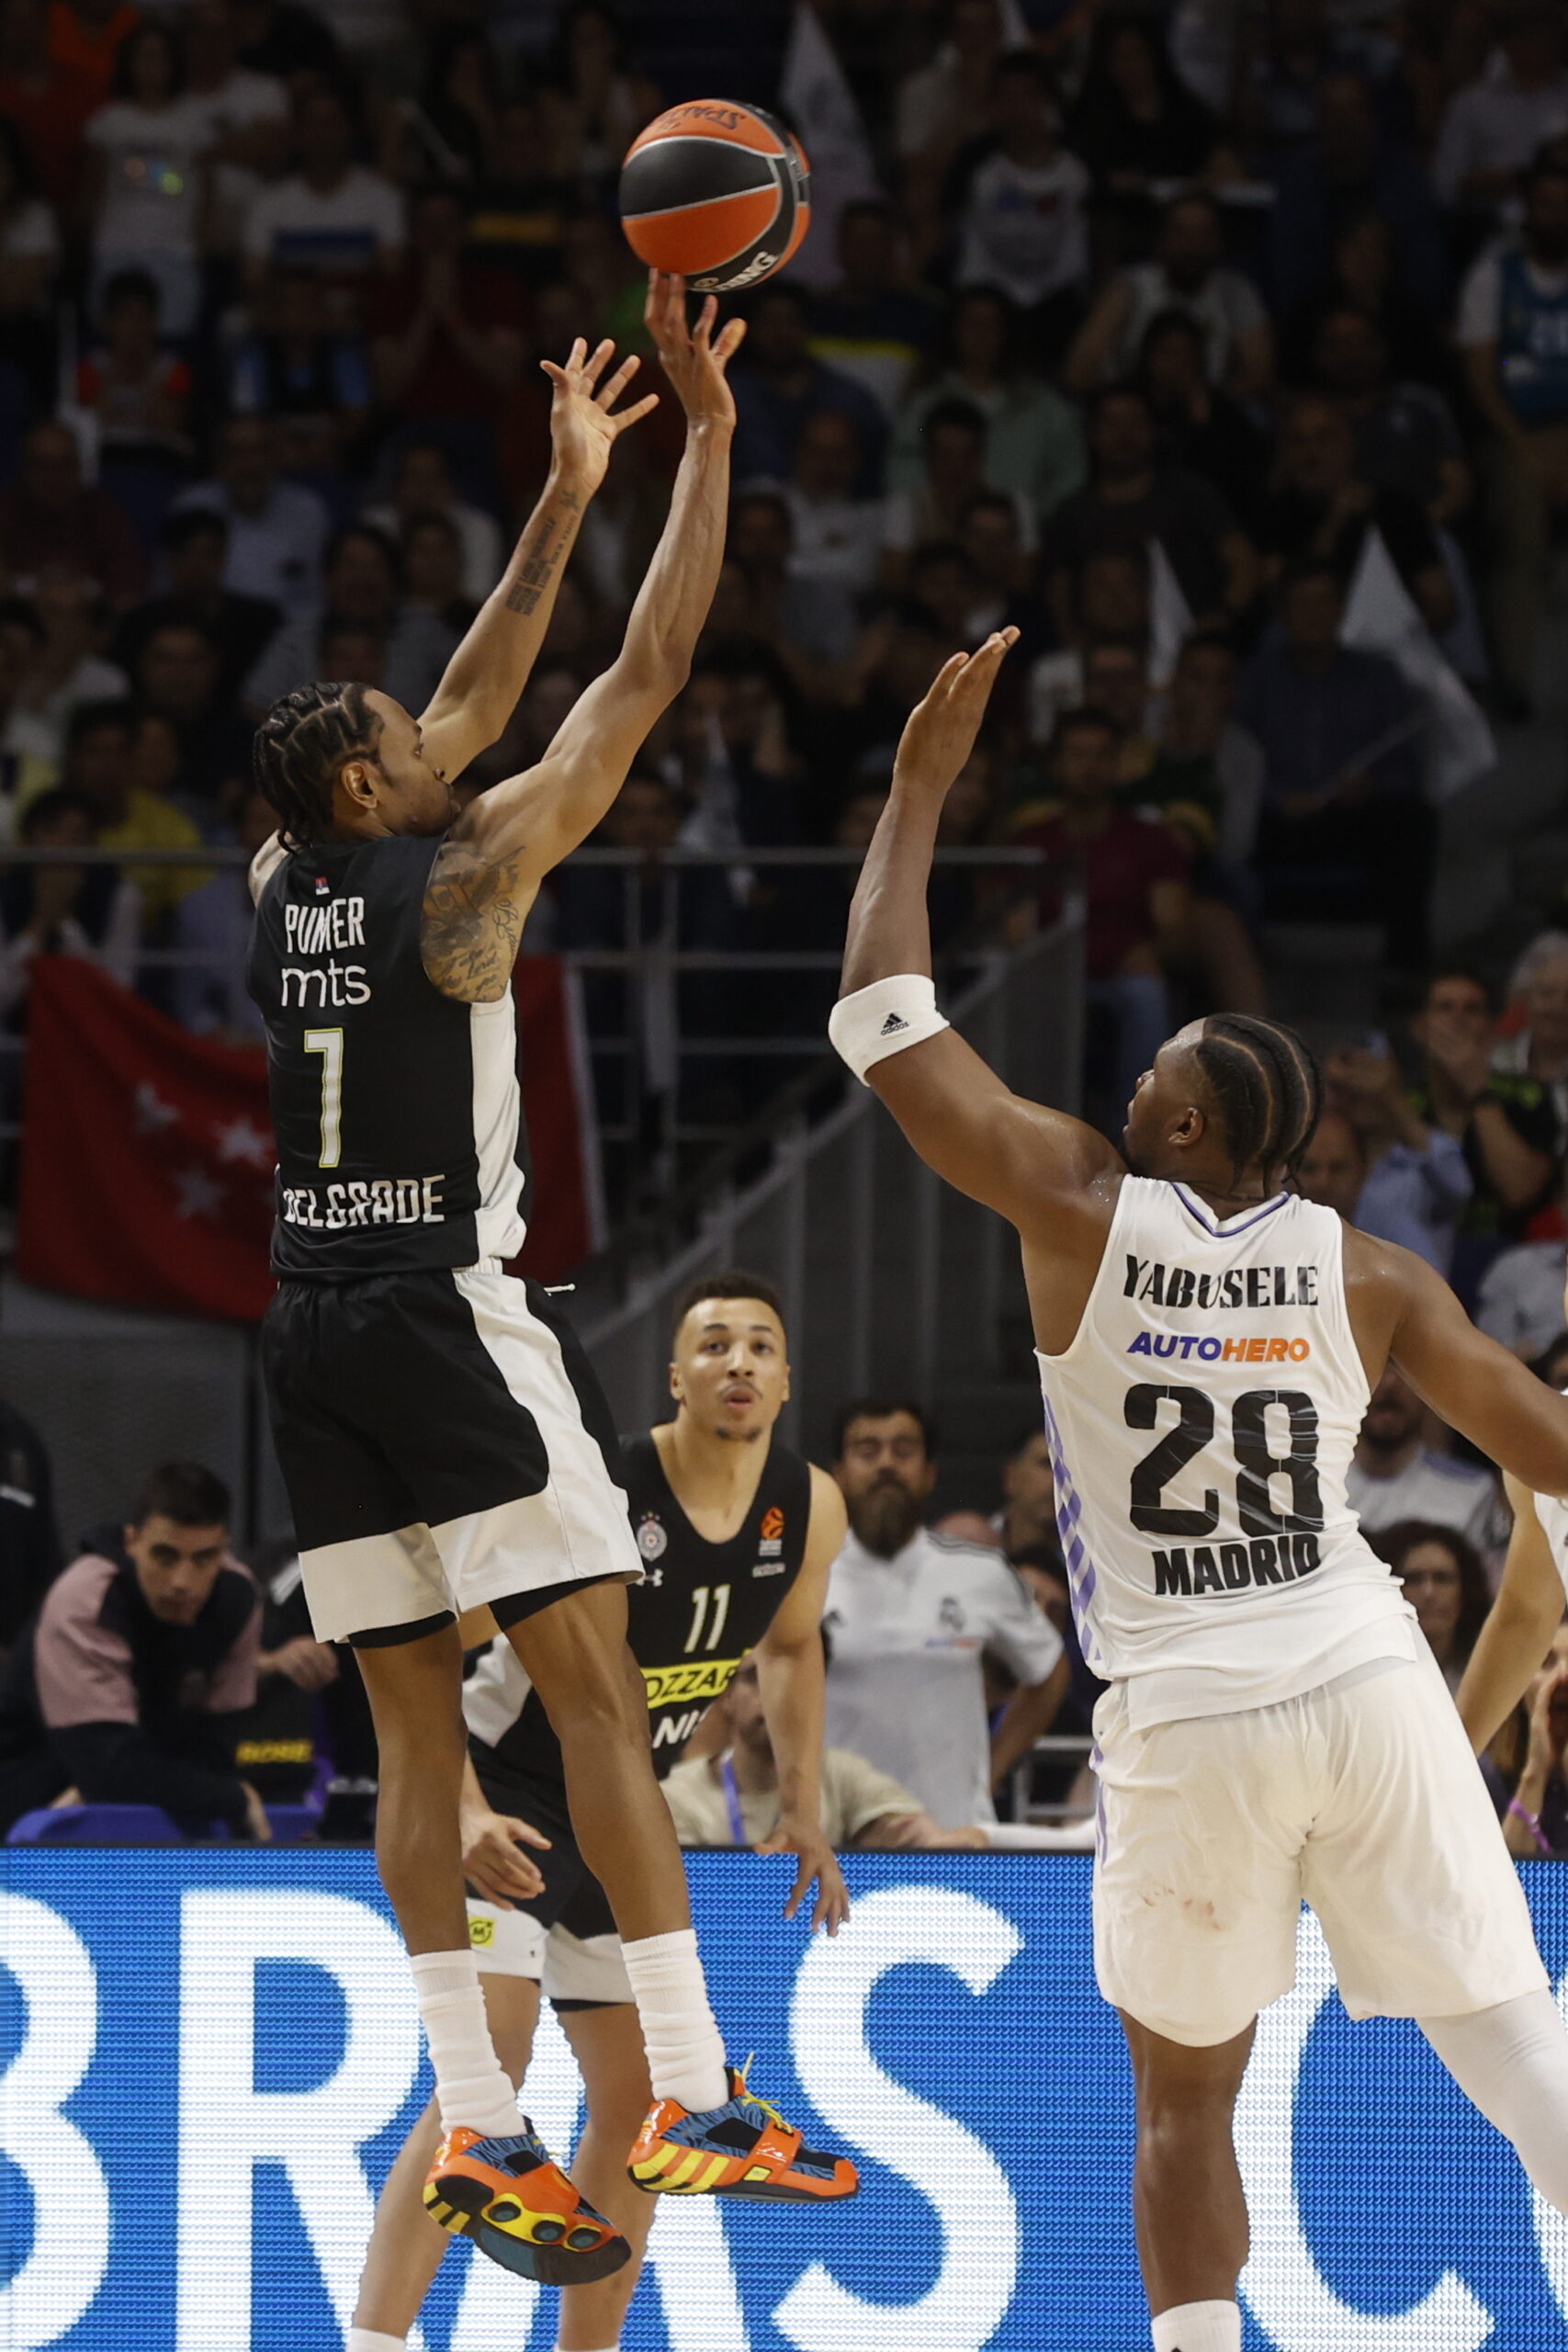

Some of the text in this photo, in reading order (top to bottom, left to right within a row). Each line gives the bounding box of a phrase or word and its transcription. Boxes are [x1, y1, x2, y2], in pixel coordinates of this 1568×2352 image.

[281, 958, 372, 1008] mts
[881, 1022, 909, 1036] adidas
[304, 1027, 344, 1169] 7
[1123, 1254, 1319, 1309] YABUSELE
[1127, 1331, 1310, 1363] AUTOHERO
[1124, 1383, 1325, 1538] 28
[1152, 1532, 1322, 1596] MADRID
[684, 1583, 731, 1654] 11
